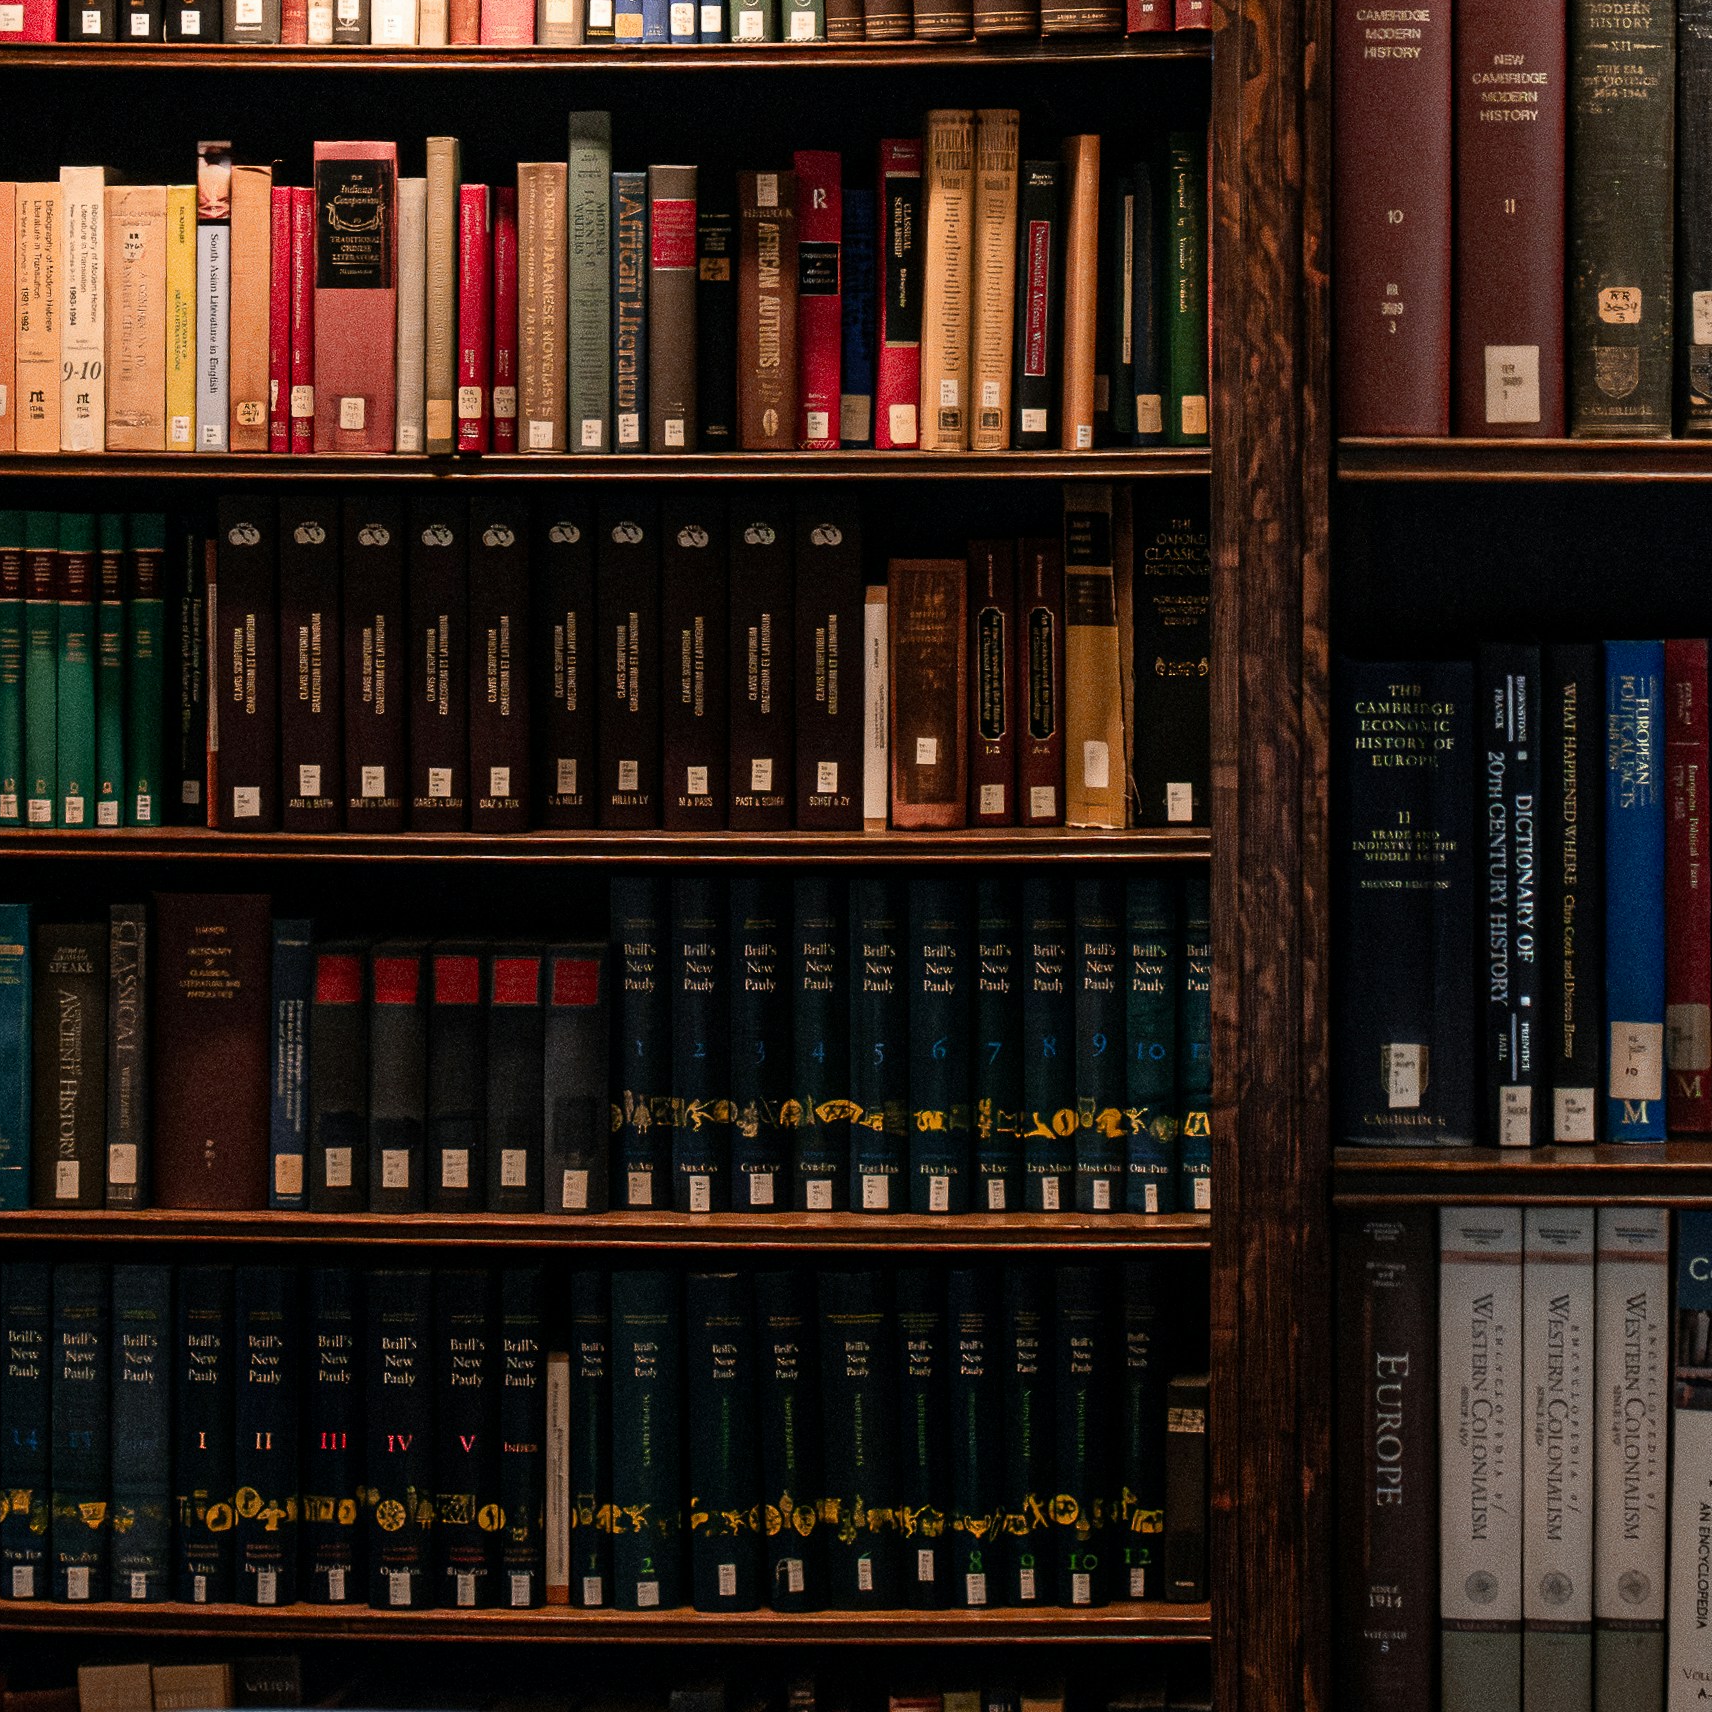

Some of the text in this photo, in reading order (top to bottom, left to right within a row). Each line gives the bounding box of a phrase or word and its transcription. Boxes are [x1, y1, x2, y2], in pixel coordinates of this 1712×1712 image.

[1356, 8, 1430, 22] CAMBRIDGE
[1365, 27, 1421, 40] MODERN
[1364, 46, 1422, 59] HISTORY
[1494, 54, 1524, 66] NEW
[1472, 72, 1548, 85] CAMBRIDGE
[1482, 91, 1538, 104] MODERN
[1480, 109, 1539, 122] HISTORY
[1387, 209, 1404, 224] 10
[210, 233, 219, 264] South
[758, 222, 781, 368] AFRICAN AUTHORS
[210, 295, 219, 342] Literature
[62, 361, 102, 382] 9-10
[208, 357, 219, 394] English
[1488, 750, 1510, 1007] 20TH CENTURY HISTORY
[1514, 793, 1535, 964] DICTIONARY OF
[624, 943, 657, 957] Brill's
[626, 960, 654, 973] New
[624, 977, 656, 993] Pauly
[382, 1335, 417, 1352] Brill's
[384, 1354, 413, 1368] New
[382, 1371, 417, 1388] Pauly
[1470, 1292, 1494, 1541] WESTERN COLONIALISM
[1546, 1293, 1570, 1541] WESTERN COLONIALISM
[1623, 1291, 1647, 1541] WESTERN COLONIALISM
[1375, 1350, 1409, 1508] EUROPE
[254, 1431, 273, 1450] II
[319, 1430, 348, 1451] III
[387, 1433, 414, 1453] IV
[458, 1433, 476, 1453] V
[1695, 1501, 1712, 1631] AN ENCYCLOPEDIA
